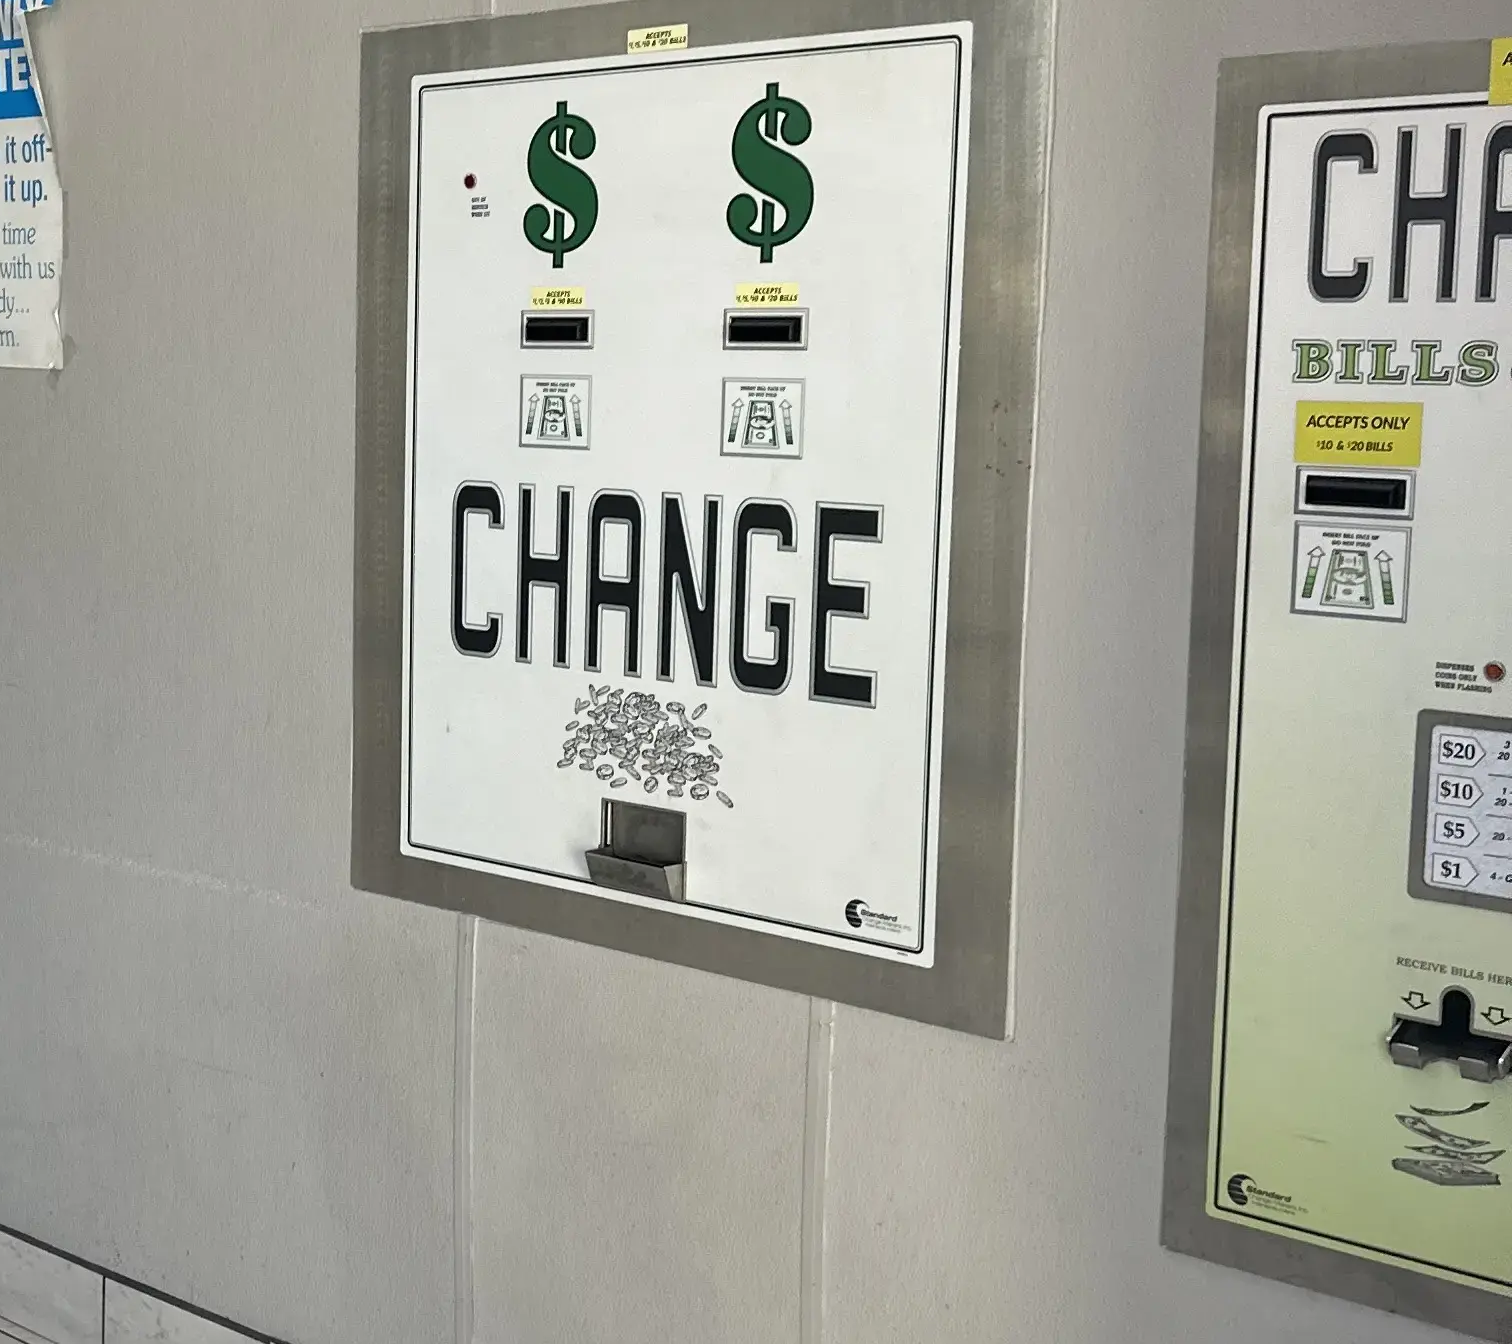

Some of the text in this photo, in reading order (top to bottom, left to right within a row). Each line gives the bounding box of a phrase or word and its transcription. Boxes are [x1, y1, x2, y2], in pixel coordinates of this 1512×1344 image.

[5, 135, 16, 164] it
[4, 173, 15, 203] it
[21, 178, 47, 208] up.
[2, 221, 36, 245] time
[0, 253, 32, 279] with
[38, 262, 55, 279] us
[1292, 338, 1500, 387] BILLS
[1306, 415, 1410, 430] ACCEPTS ONLY
[1316, 440, 1393, 452] $10 & $20 BILLS
[450, 479, 885, 709] CHANGE
[1457, 683, 1492, 693] FLASHING
[1442, 740, 1476, 760] $20
[1497, 751, 1510, 761] 20
[1440, 780, 1473, 801] $10
[1494, 797, 1507, 806] 20
[1443, 820, 1505, 841] $5 20
[1441, 861, 1462, 879] $1
[1490, 872, 1496, 880] 4
[1396, 956, 1448, 974] RECEIVE
[1451, 966, 1484, 981] BILLS
[1246, 1185, 1292, 1203] Standard
